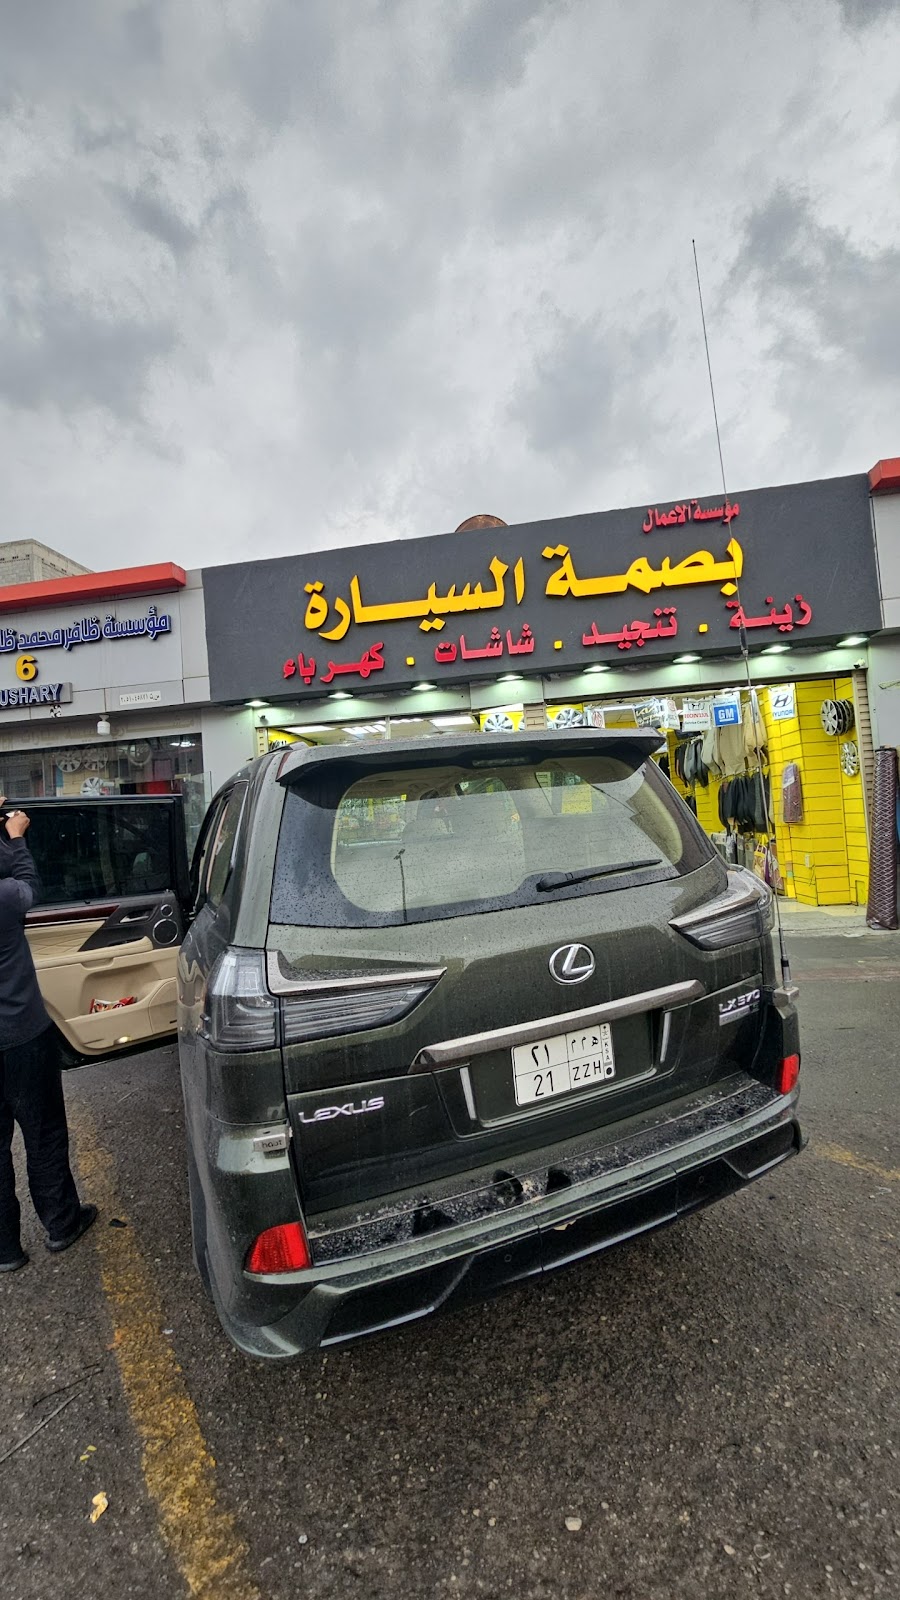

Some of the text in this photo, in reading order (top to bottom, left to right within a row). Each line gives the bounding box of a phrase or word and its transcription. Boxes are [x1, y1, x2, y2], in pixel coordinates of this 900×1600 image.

[303, 537, 744, 641] بصمة السيارة
[102, 606, 171, 640] مؤسسة
[17, 629, 63, 650] محمد
[282, 594, 813, 685] زينة تنجيد شاشات كهرباء
[15, 654, 38, 681] 6
[718, 708, 735, 720] GM
[534, 1060, 602, 1097] 21 ZZH
[299, 1096, 385, 1123] LEXUS
